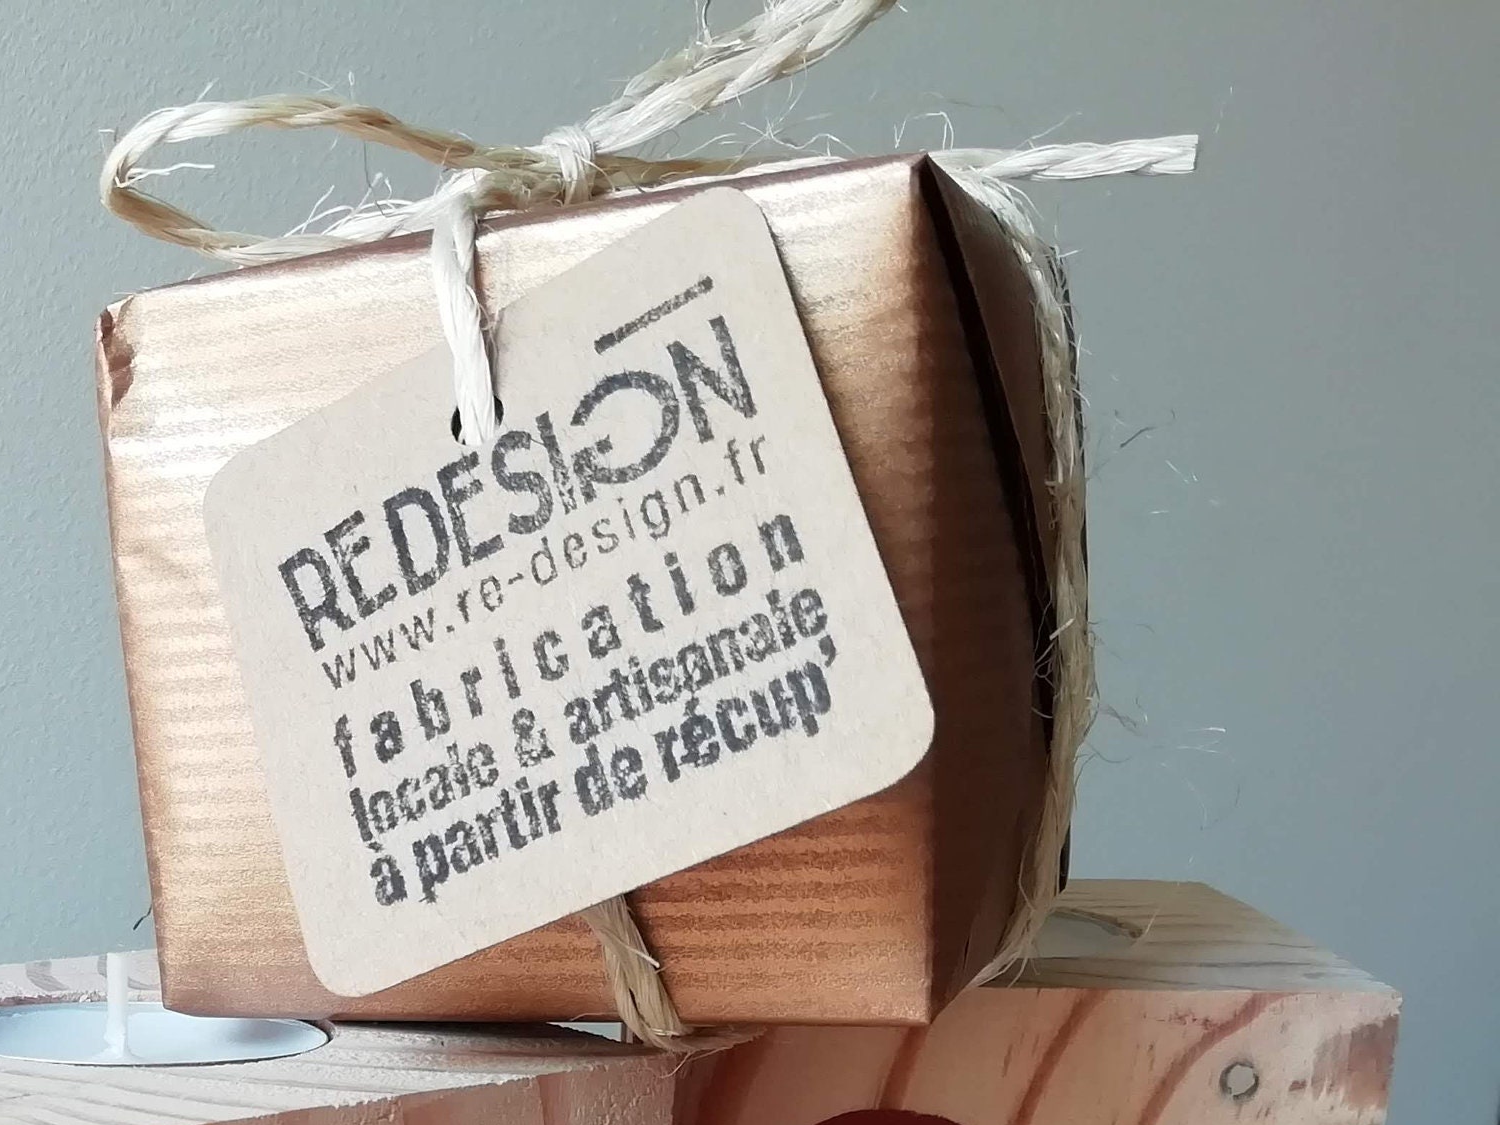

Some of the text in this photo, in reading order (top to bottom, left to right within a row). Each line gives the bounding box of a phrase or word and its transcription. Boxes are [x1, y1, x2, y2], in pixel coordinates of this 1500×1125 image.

[321, 434, 768, 690] www.re-design.fr
[334, 514, 804, 778] fabrication
[349, 588, 828, 842] locale & artisanale
[370, 841, 407, 906] à
[413, 777, 563, 903] partir
[574, 743, 648, 815] de
